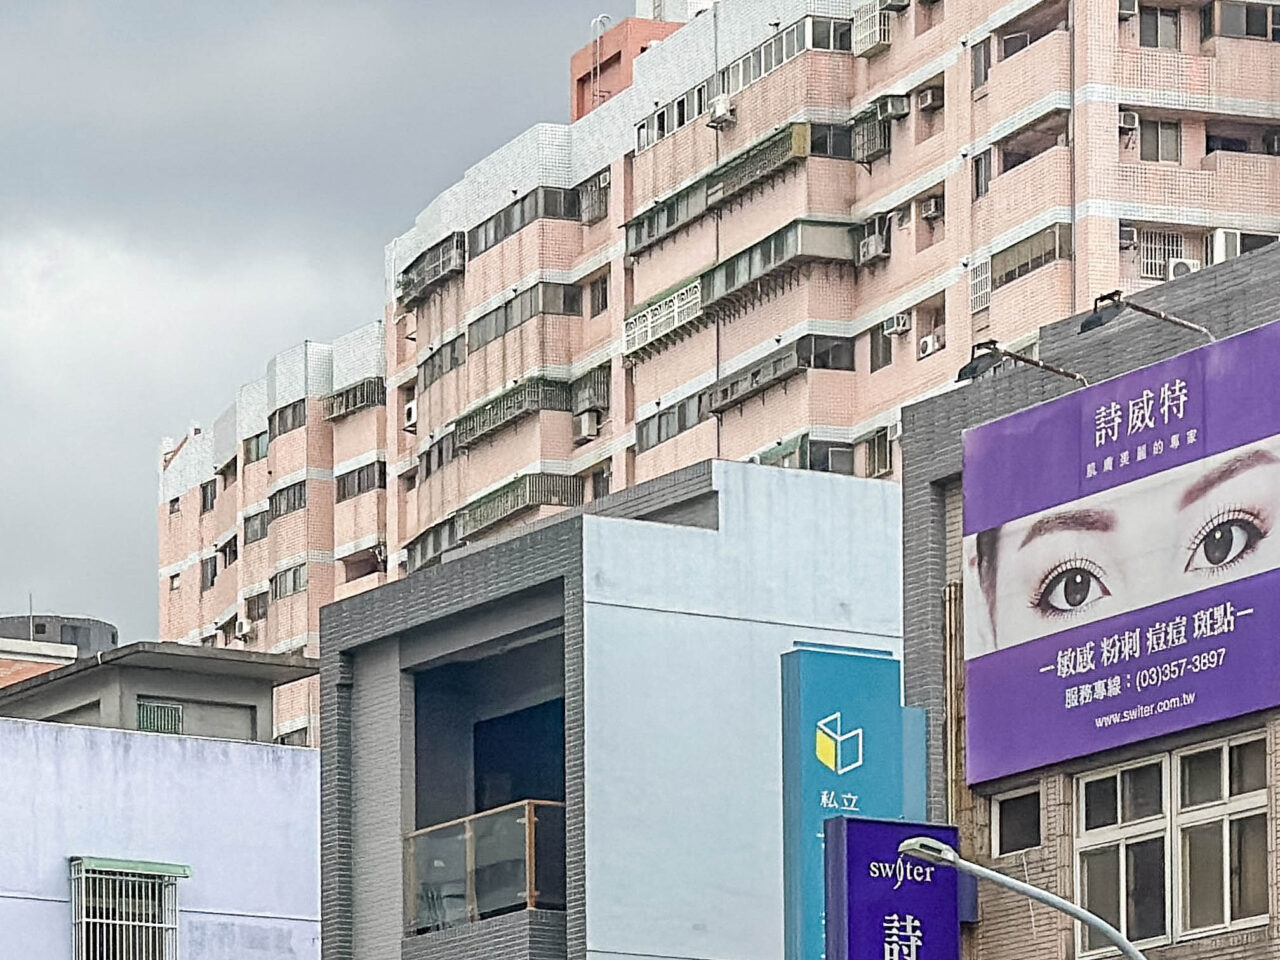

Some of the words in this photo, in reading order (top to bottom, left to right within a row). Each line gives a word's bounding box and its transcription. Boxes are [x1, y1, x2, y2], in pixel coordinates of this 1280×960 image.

[1095, 379, 1188, 448] 詩威特
[1101, 628, 1140, 667] 粉刺
[1146, 616, 1187, 655] 痘痘
[1136, 648, 1226, 692] (03)357-3897
[1095, 691, 1196, 728] www.switer.com.tw
[820, 790, 859, 811] 私立
